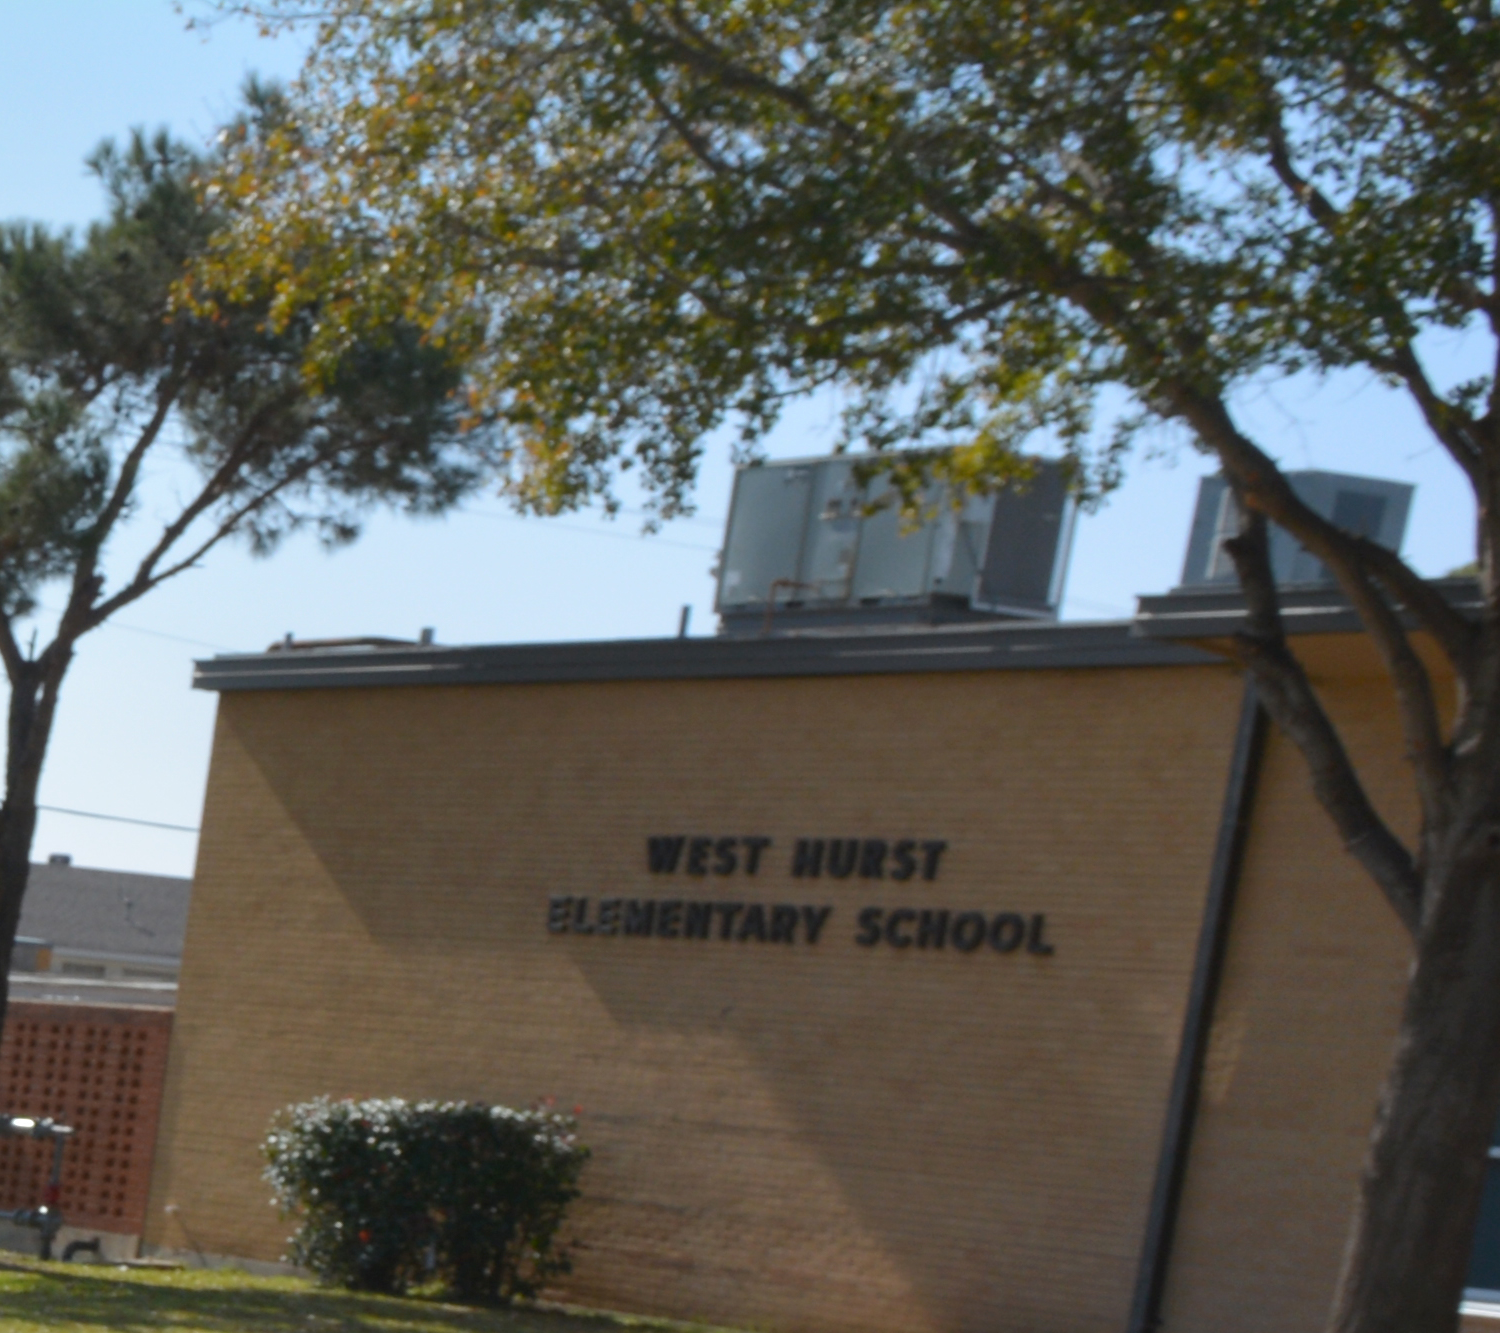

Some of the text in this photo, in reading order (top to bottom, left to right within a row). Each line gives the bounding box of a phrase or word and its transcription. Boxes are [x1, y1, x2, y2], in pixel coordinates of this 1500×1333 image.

[647, 836, 947, 881] WEST HURST
[547, 895, 1054, 955] ELEMENTARY SCHOOL
